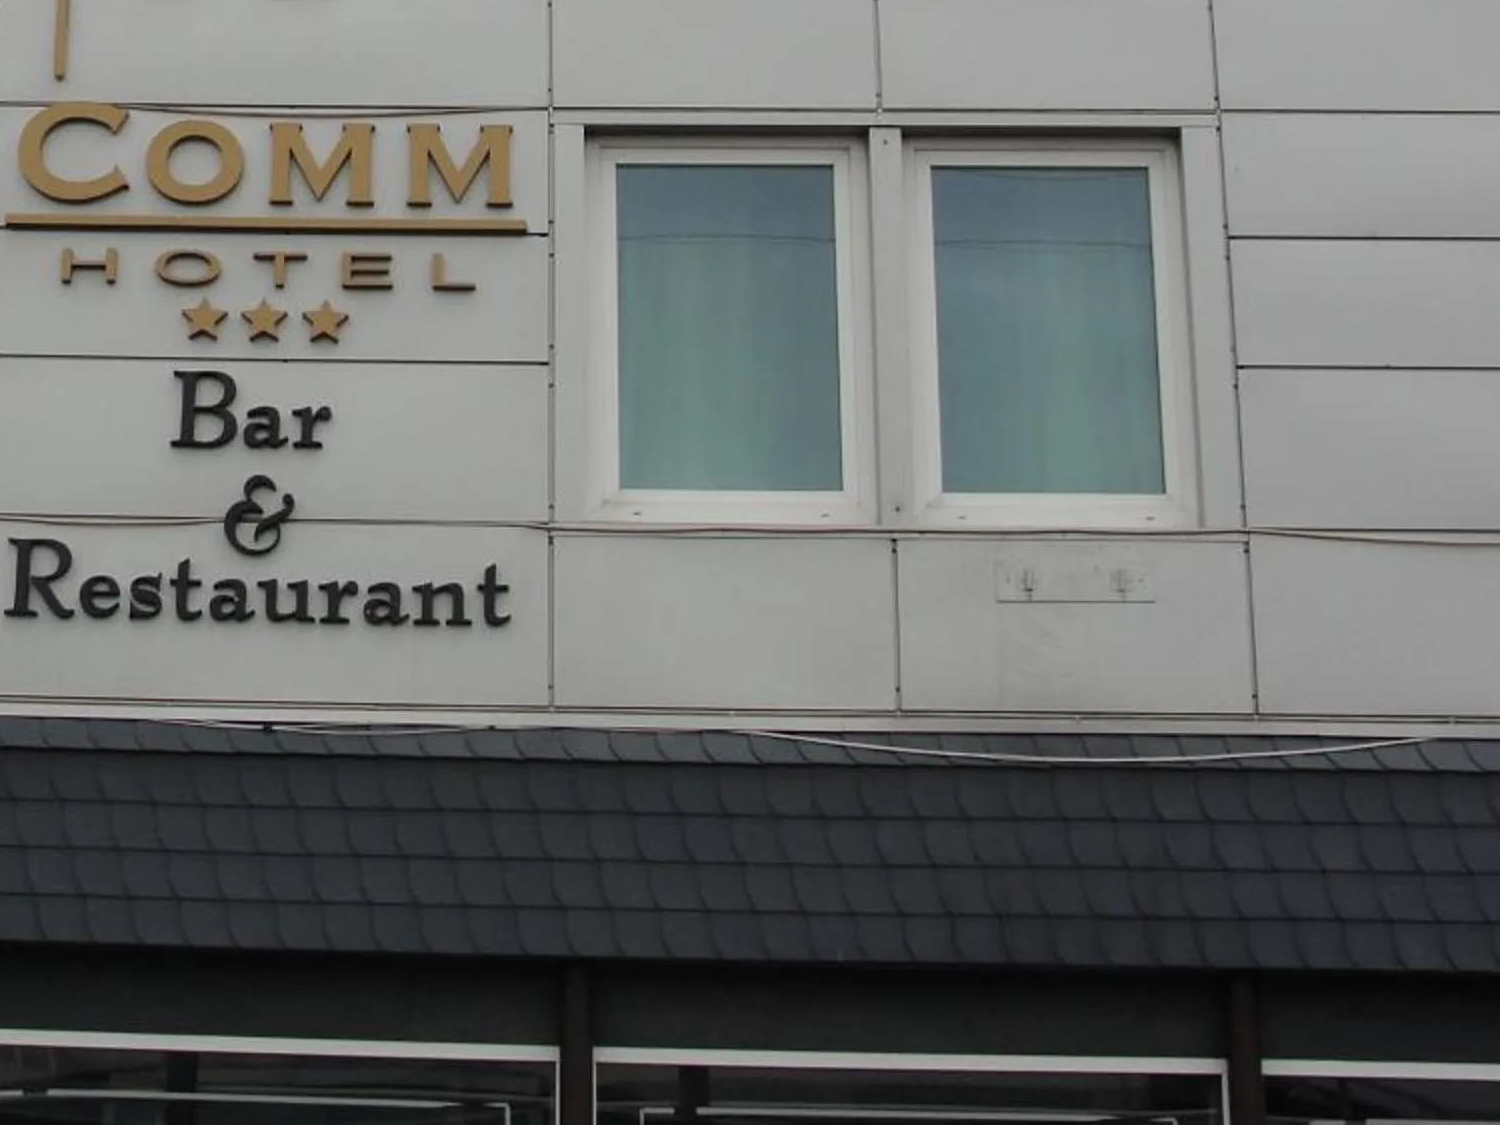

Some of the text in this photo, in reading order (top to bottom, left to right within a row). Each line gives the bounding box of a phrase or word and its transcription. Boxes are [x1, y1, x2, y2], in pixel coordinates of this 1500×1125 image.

[17, 101, 514, 208] COMM
[60, 248, 477, 291] HOTEL
[170, 369, 332, 451] Bar
[224, 474, 295, 557] &
[3, 536, 513, 629] Restaurant
